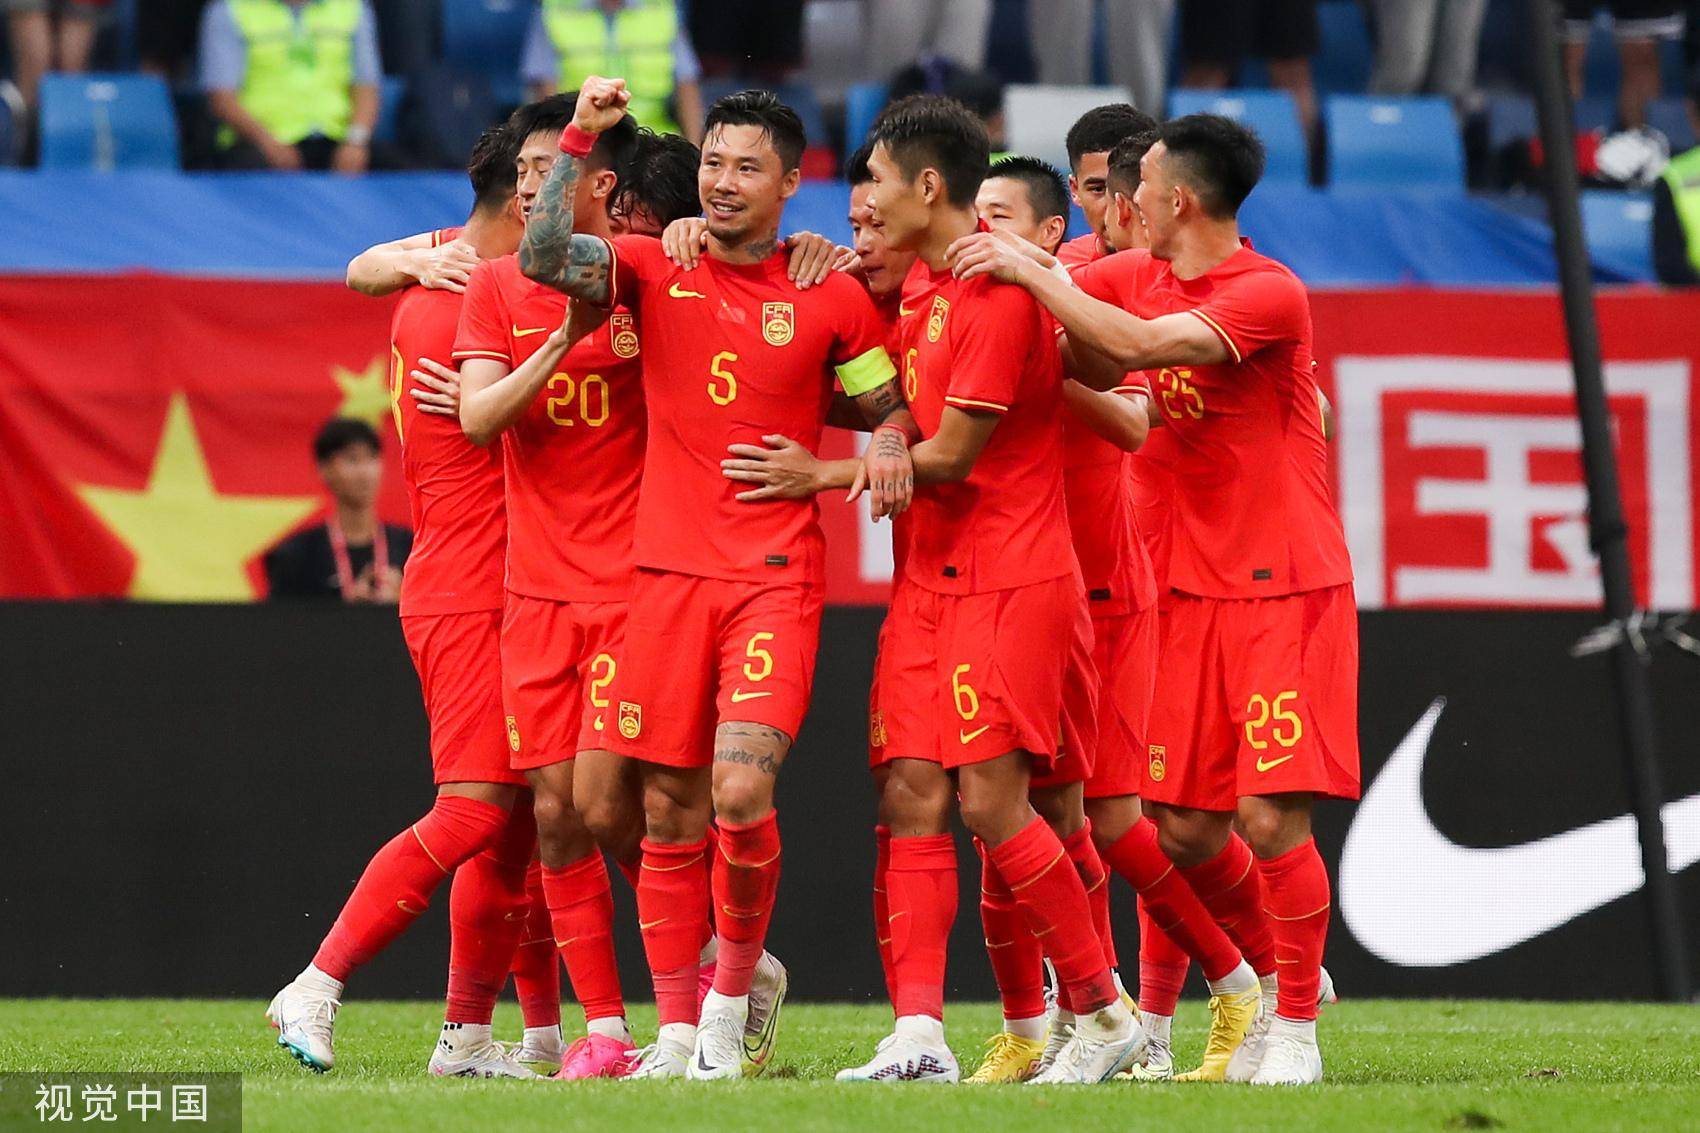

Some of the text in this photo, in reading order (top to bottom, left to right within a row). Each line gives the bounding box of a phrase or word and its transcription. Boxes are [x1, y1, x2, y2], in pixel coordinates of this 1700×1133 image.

[547, 372, 609, 427] 20
[707, 351, 738, 406] 5
[906, 348, 918, 402] 6
[1158, 368, 1204, 419] 25
[1334, 355, 1693, 611] 国
[743, 632, 775, 682] 5
[952, 664, 980, 720] 6
[1246, 691, 1303, 749] 25
